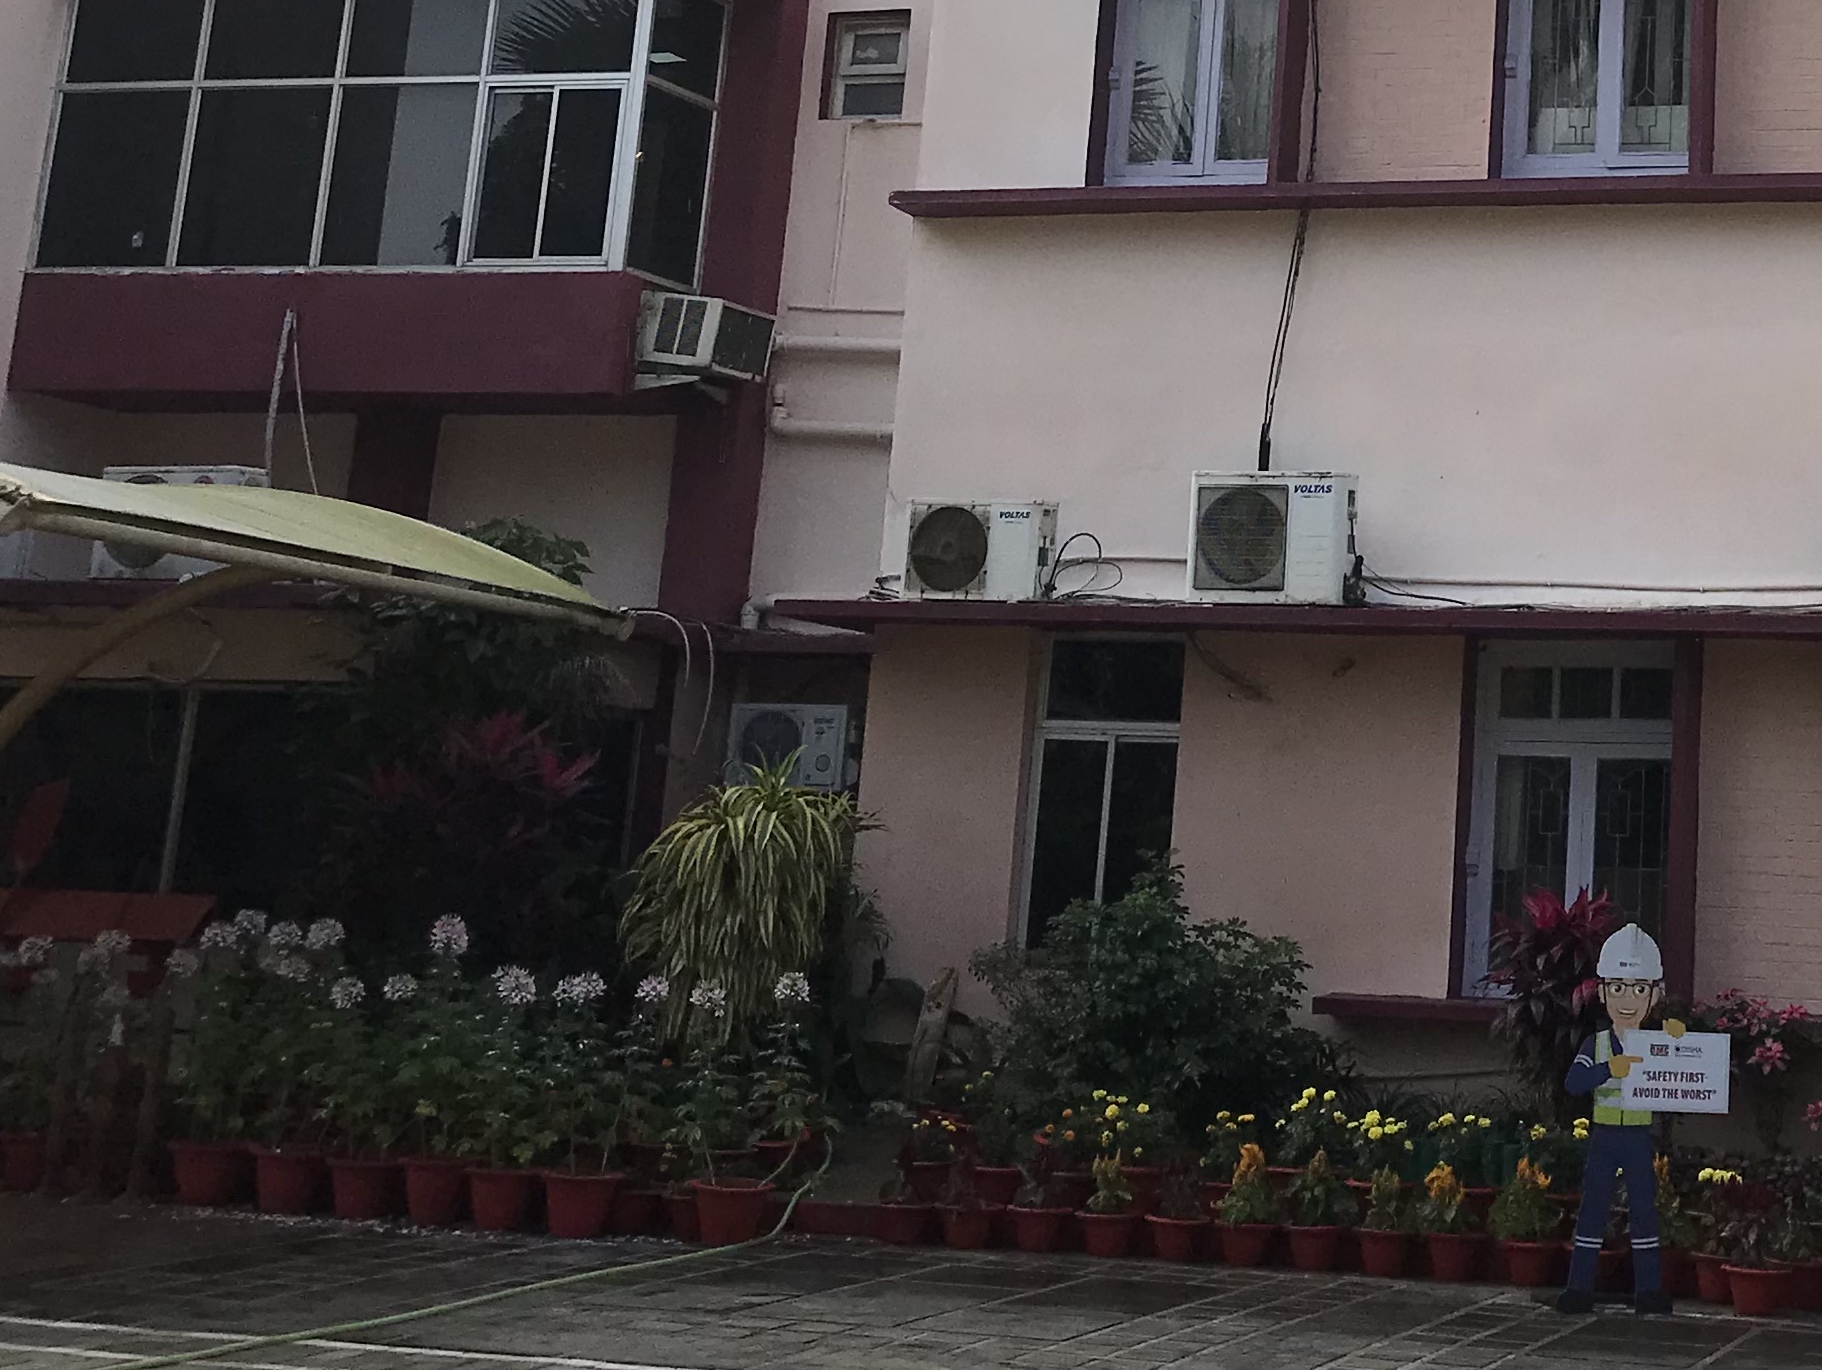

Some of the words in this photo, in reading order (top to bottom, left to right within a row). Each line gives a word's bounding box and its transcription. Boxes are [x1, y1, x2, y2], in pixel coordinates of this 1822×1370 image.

[1293, 484, 1333, 494] VOLTAS
[999, 511, 1031, 519] VOLTAS
[1632, 1087, 1660, 1099] AVOID
[1662, 1088, 1679, 1099] THE
